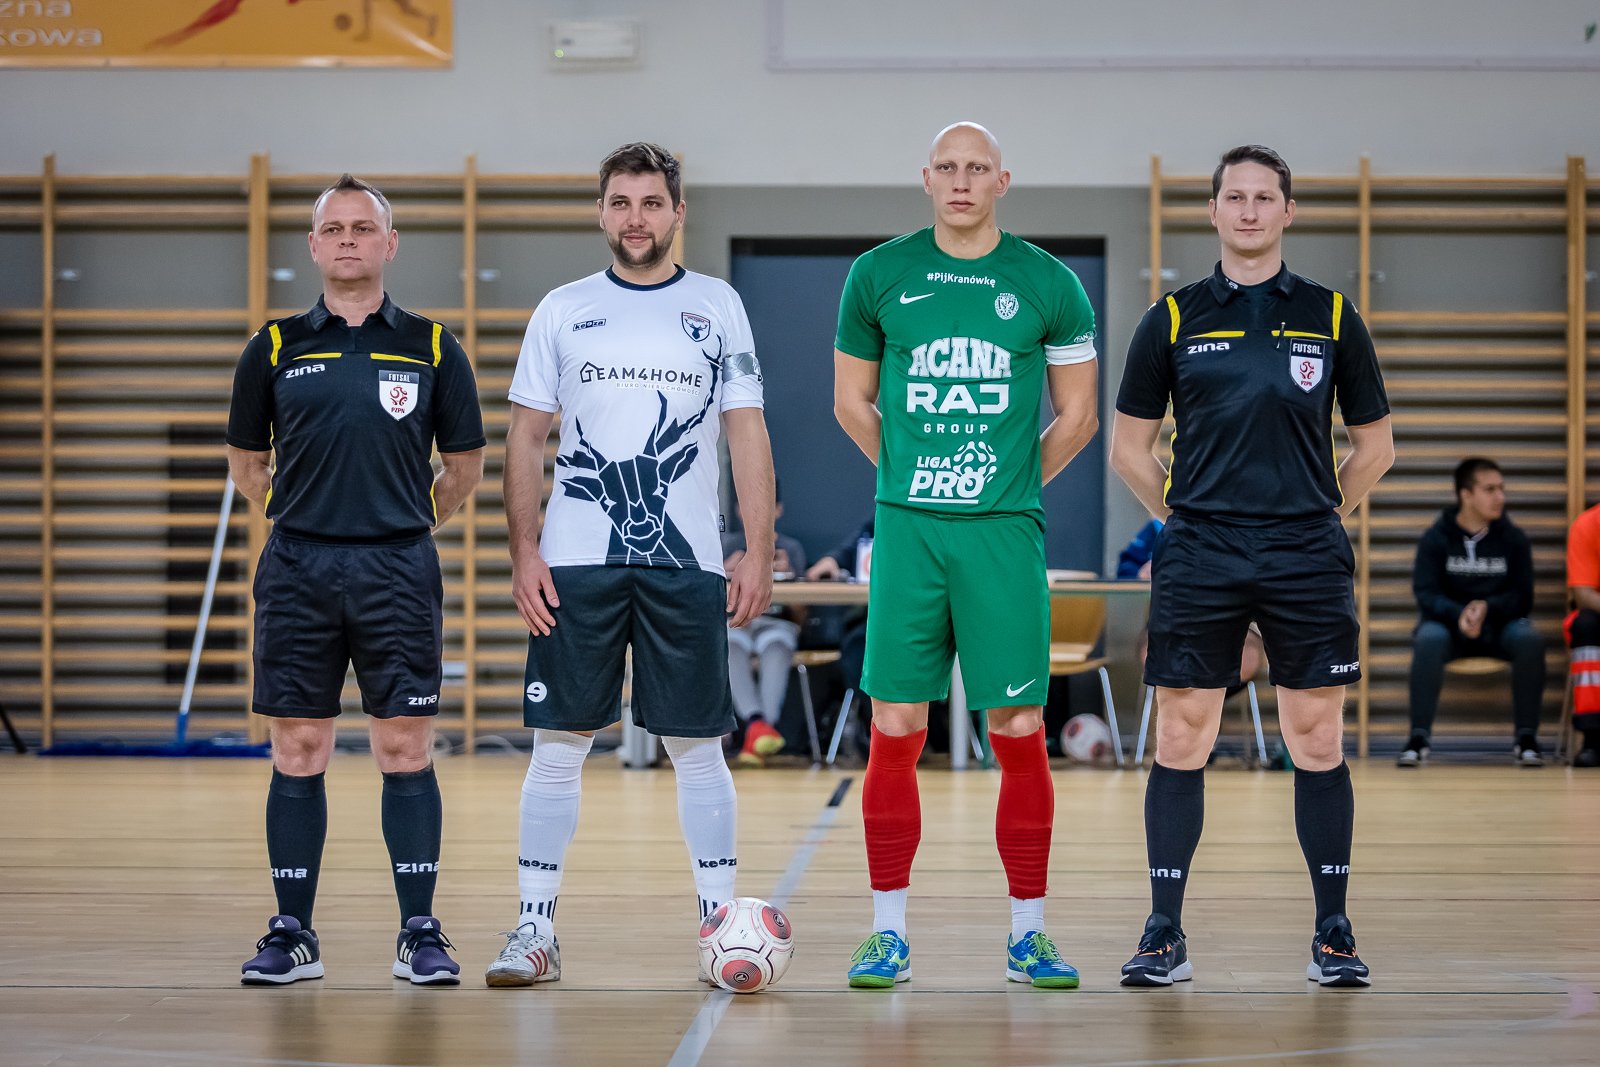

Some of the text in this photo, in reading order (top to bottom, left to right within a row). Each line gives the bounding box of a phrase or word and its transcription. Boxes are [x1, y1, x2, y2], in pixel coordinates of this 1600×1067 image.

[926, 272, 996, 288] #PijKranówkę
[1187, 341, 1230, 355] zina
[1292, 342, 1322, 355] FUTSAL
[908, 336, 1012, 378] ACANA
[285, 363, 326, 379] zina
[388, 373, 411, 383] FUTSAL
[580, 361, 703, 388] TEAM4HOME
[906, 383, 1010, 414] RAJ
[923, 422, 989, 434] GROUP
[916, 455, 951, 469] LIGA
[909, 469, 985, 499] PRO
[1330, 661, 1360, 673] zina
[408, 694, 438, 706] zina
[1149, 868, 1182, 879] ina
